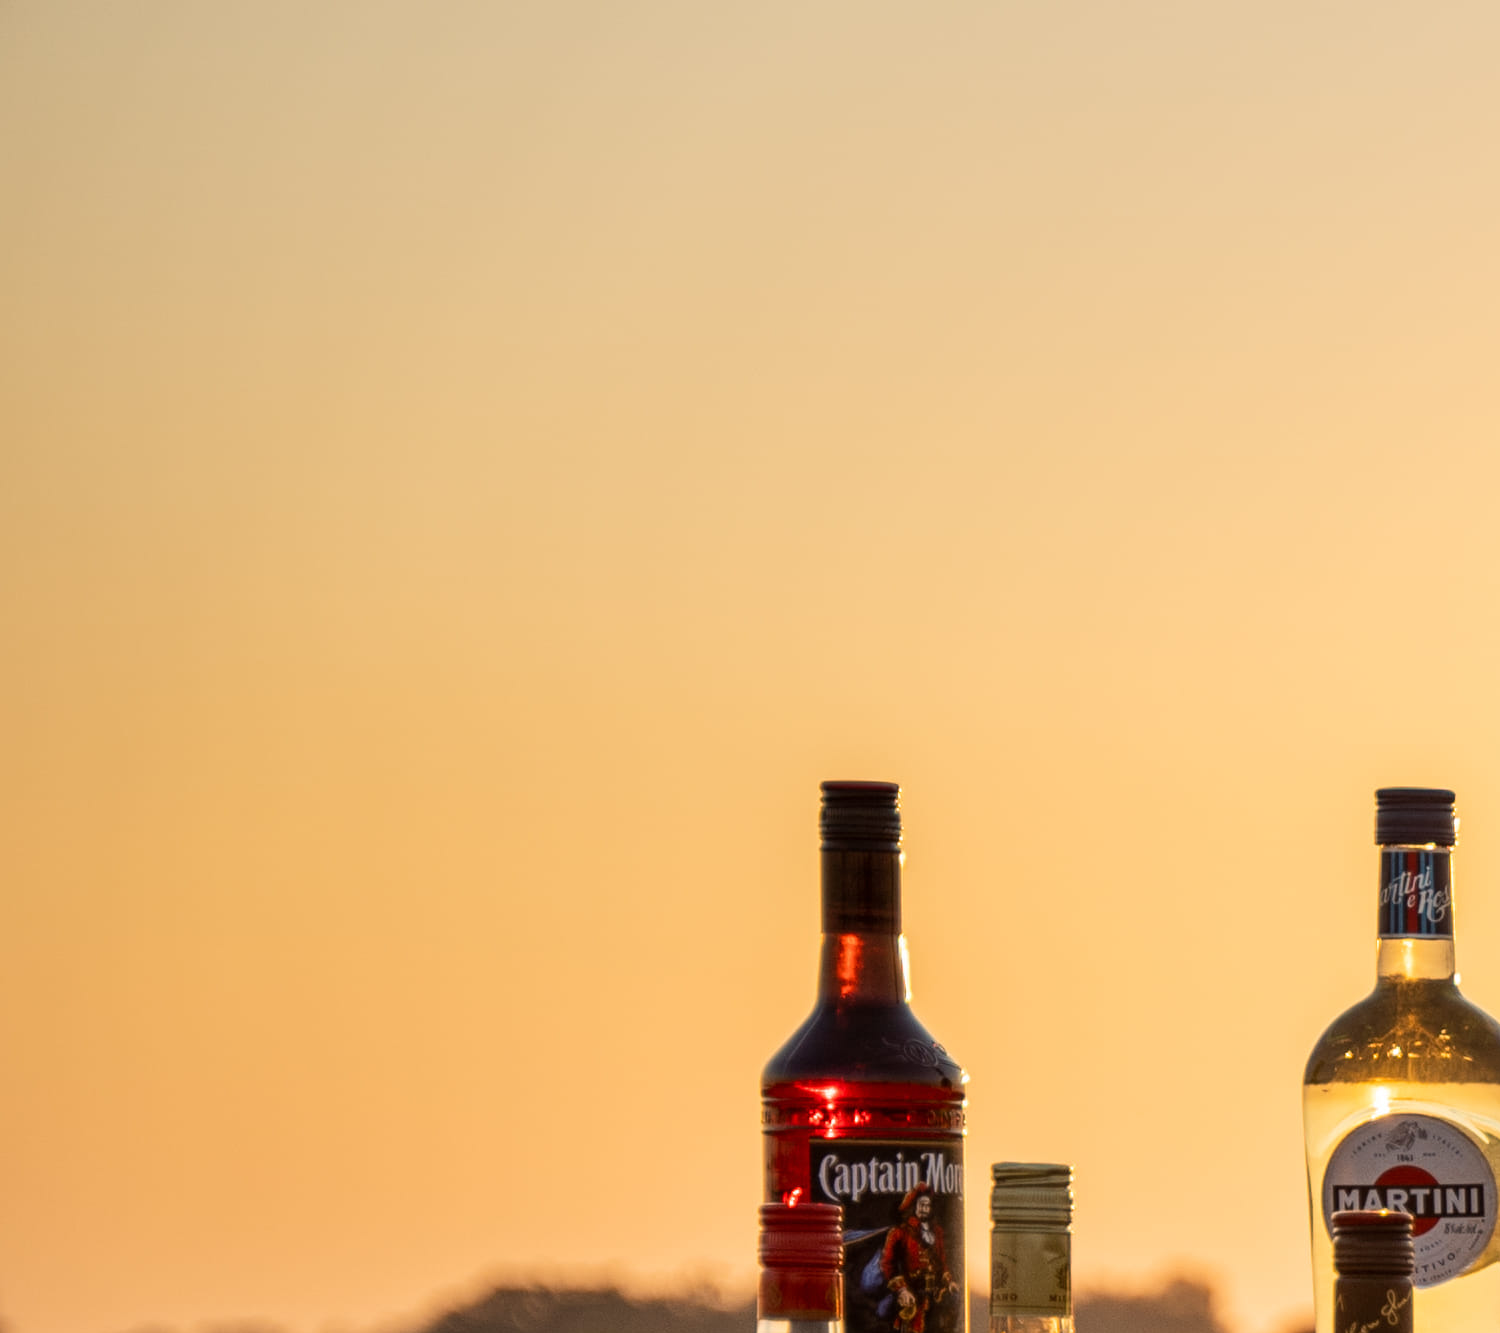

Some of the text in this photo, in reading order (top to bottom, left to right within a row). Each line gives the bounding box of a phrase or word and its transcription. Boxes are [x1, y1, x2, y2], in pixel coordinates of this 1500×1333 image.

[1380, 866, 1431, 906] artini
[818, 1153, 963, 1202] Captain Mor
[1338, 1187, 1479, 1215] MARTINI
